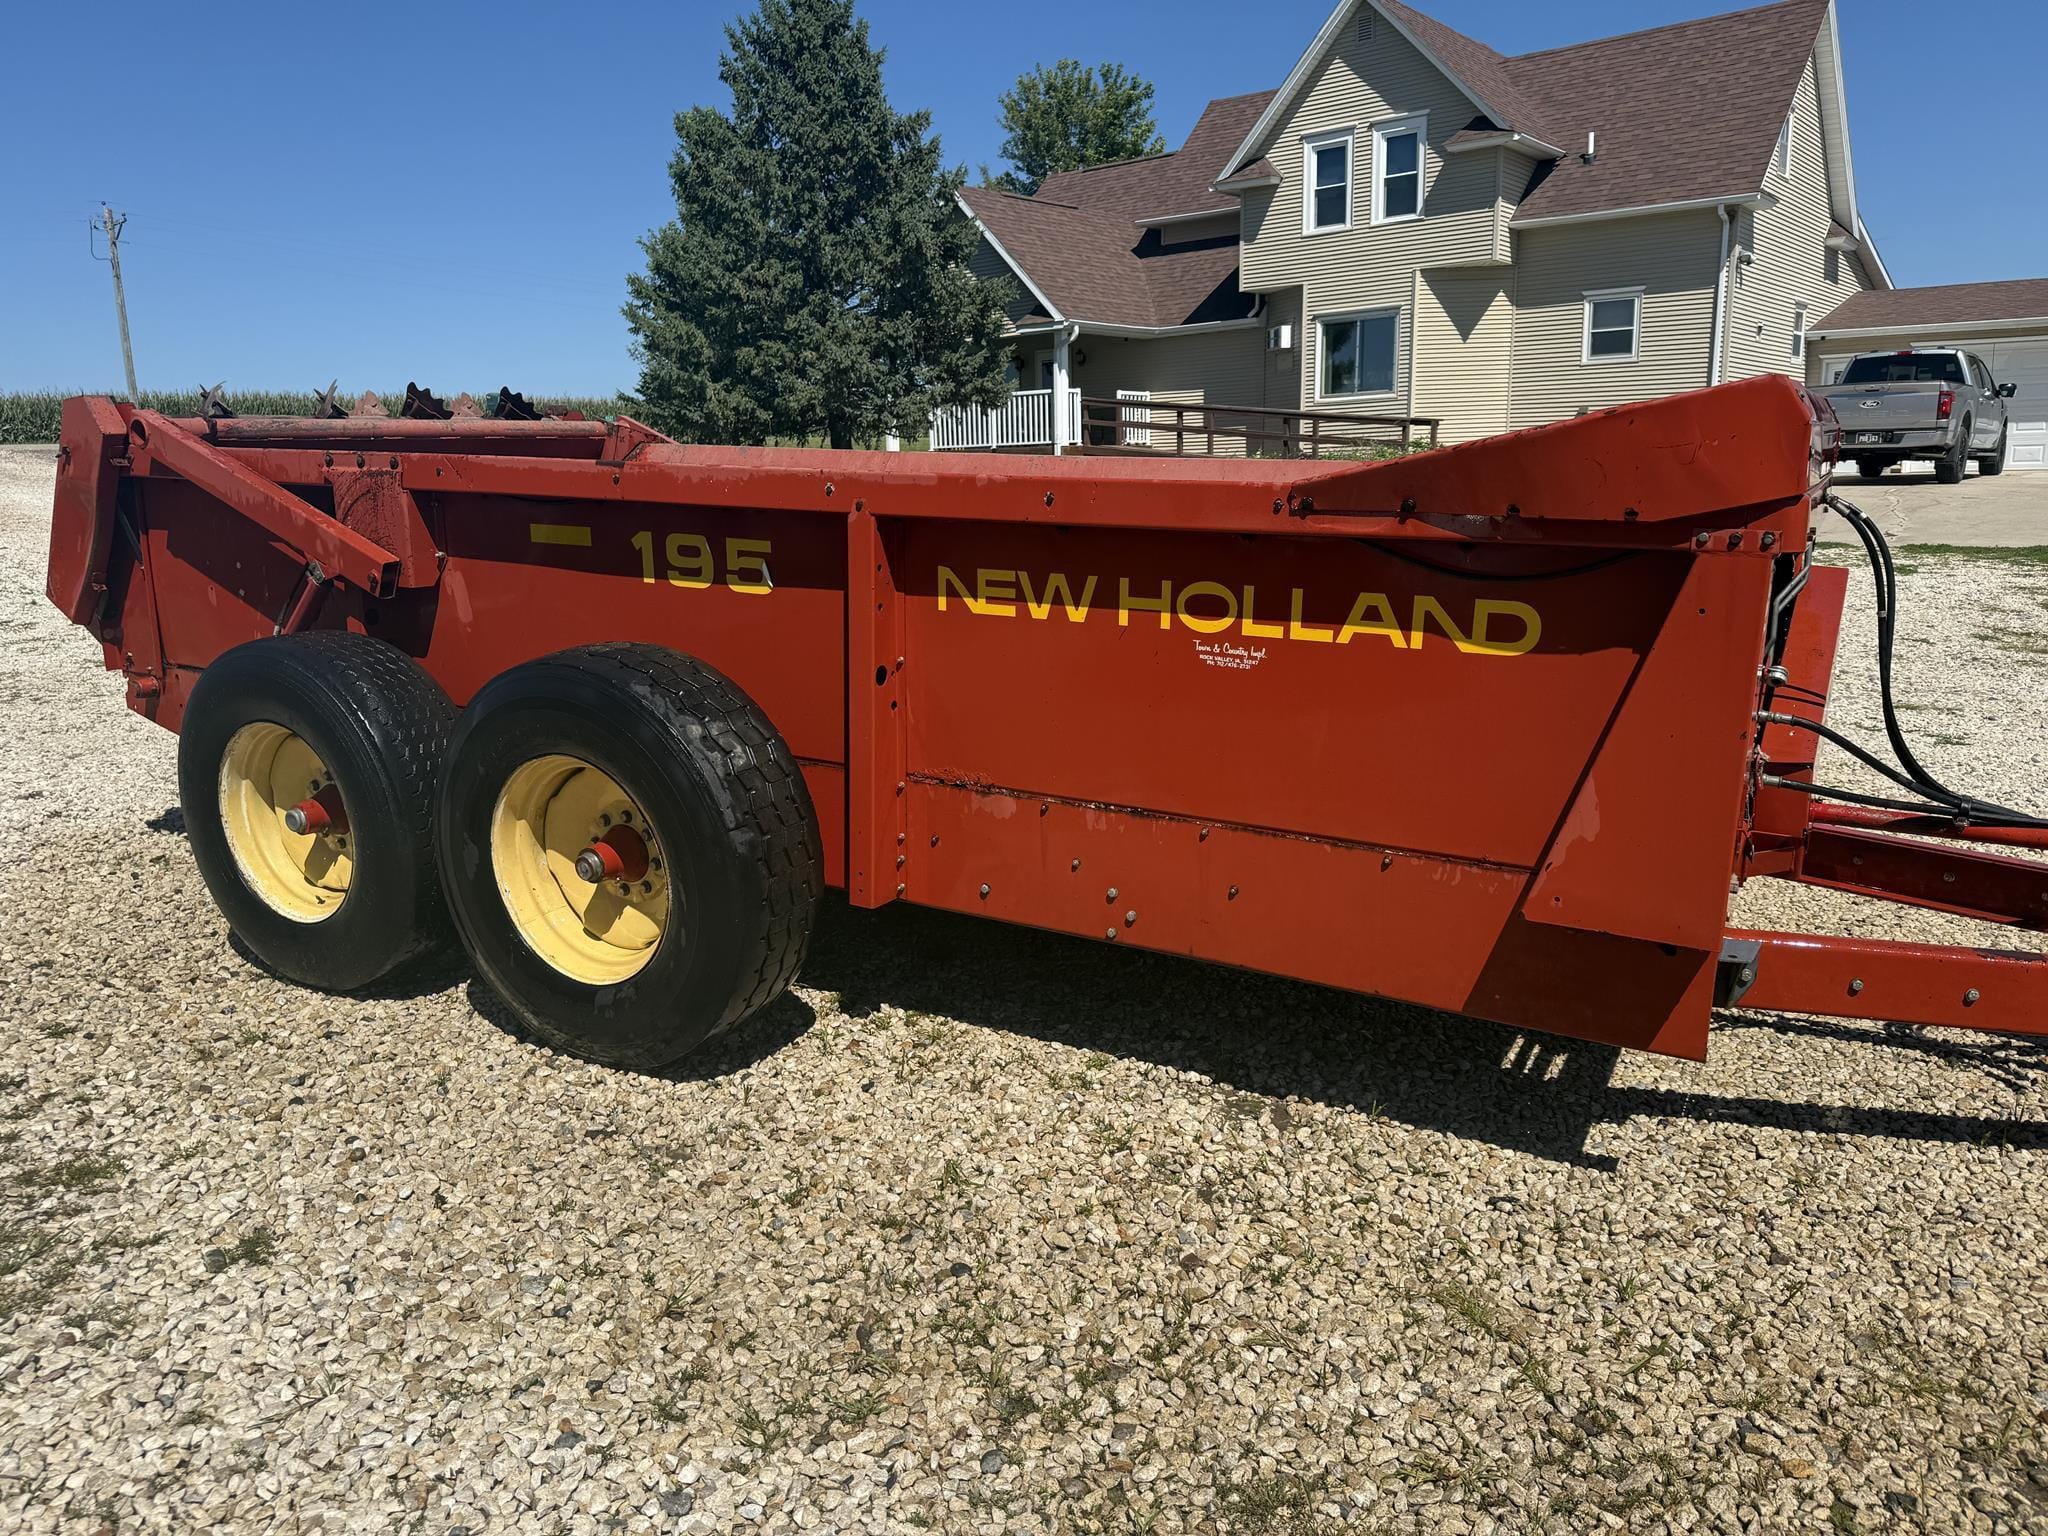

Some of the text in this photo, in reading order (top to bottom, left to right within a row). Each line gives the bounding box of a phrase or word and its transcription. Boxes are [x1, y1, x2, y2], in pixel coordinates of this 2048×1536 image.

[630, 530, 774, 595] 195
[937, 564, 1542, 656] NEW HOLLAND
[1192, 640, 1211, 652] Town
[1213, 643, 1220, 653] &
[1223, 642, 1248, 658] Country
